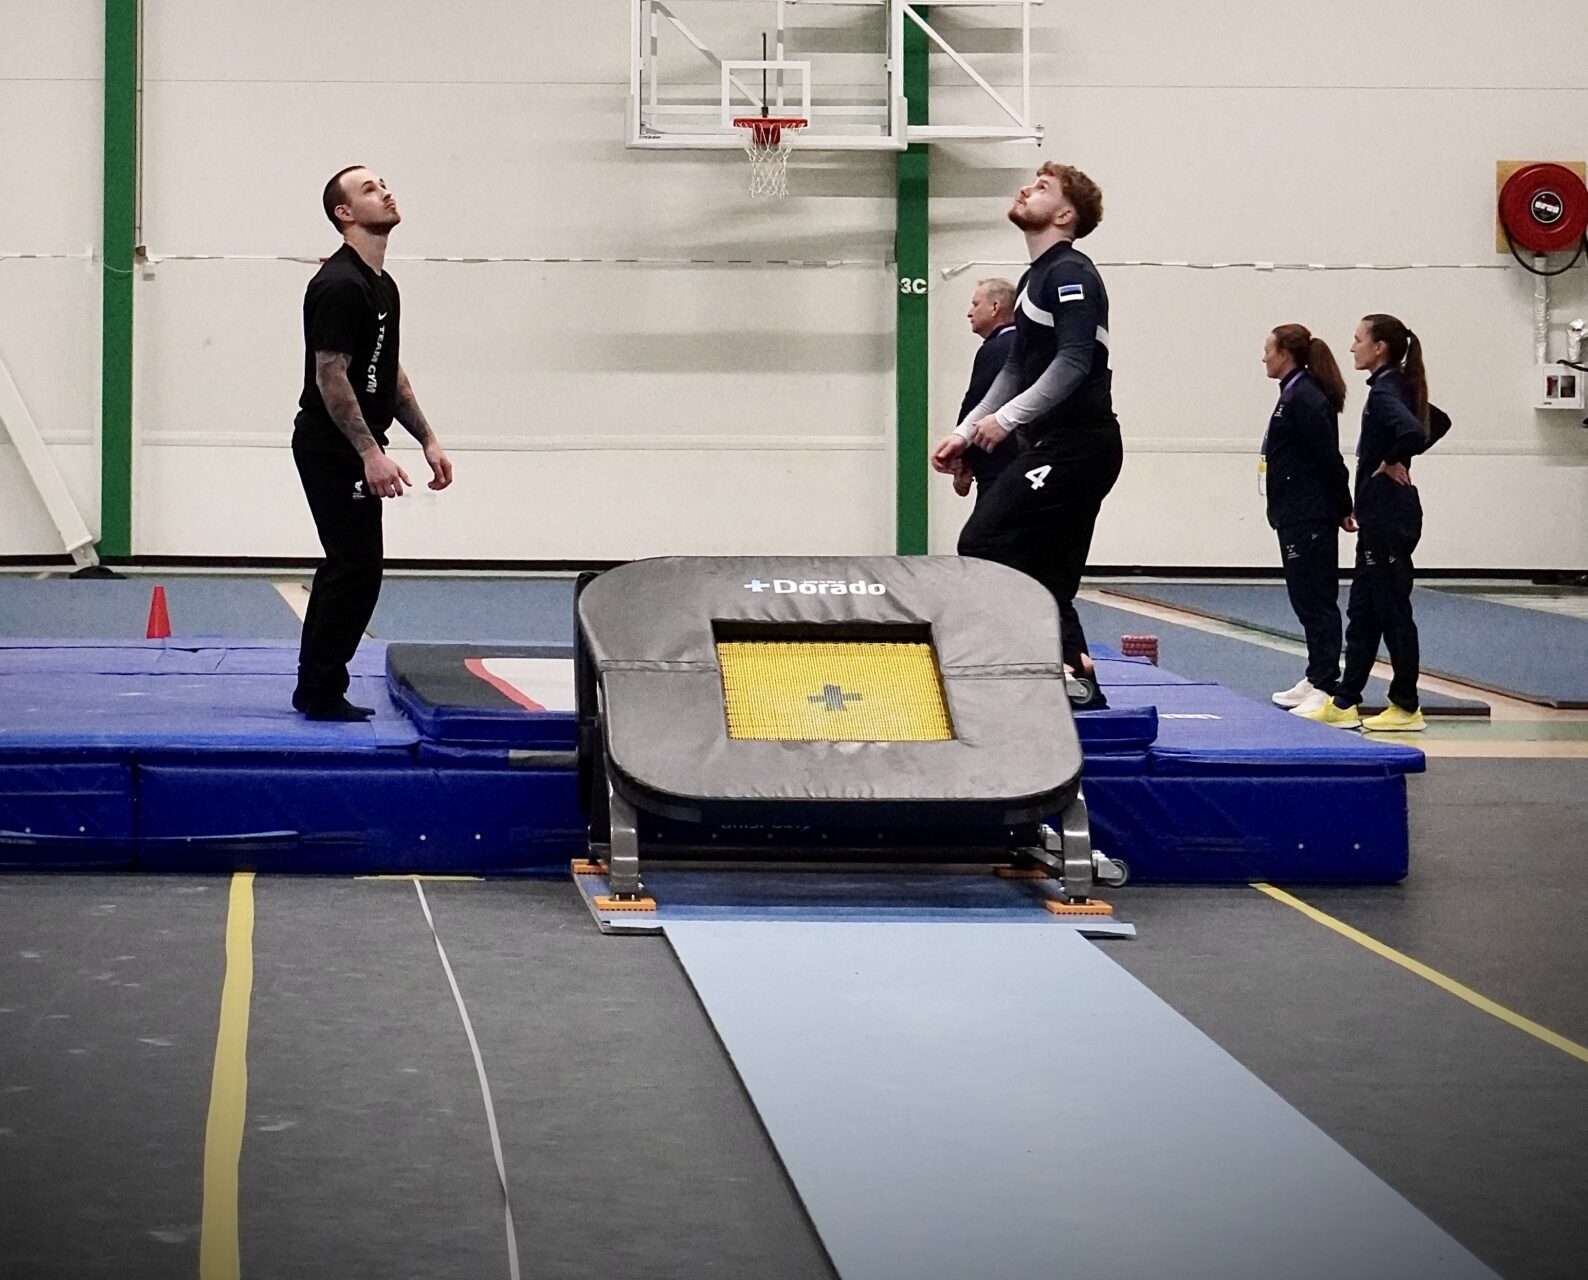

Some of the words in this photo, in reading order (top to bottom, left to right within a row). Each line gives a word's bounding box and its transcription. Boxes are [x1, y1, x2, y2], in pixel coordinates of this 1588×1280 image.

[900, 277, 927, 294] 3C
[371, 325, 385, 363] TEAM
[366, 364, 378, 393] GYM
[1024, 464, 1052, 490] 4
[773, 579, 886, 595] Dorado
